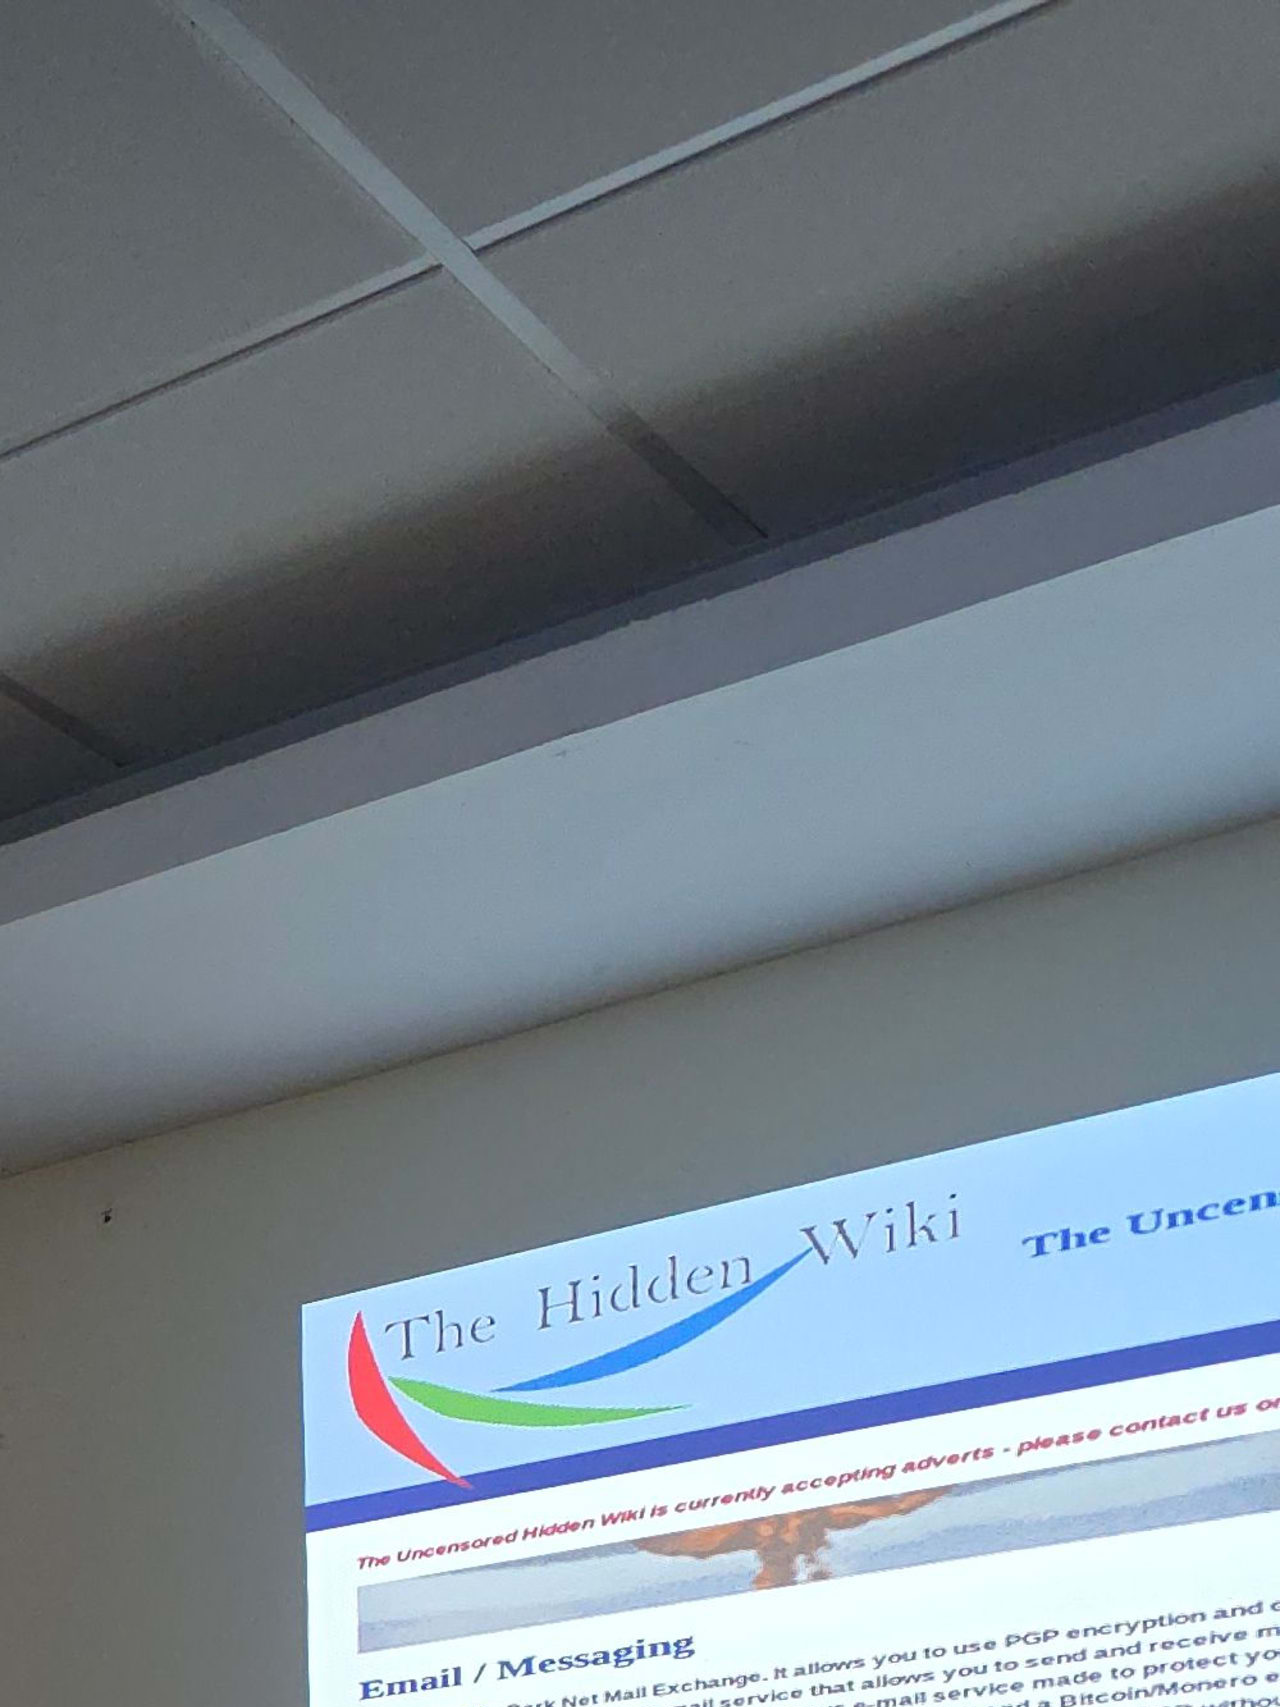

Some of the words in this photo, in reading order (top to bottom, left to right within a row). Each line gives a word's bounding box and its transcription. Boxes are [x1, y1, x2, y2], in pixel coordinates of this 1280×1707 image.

[1021, 1226, 1111, 1258] The
[1126, 1189, 1280, 1235] Uncen
[385, 1309, 496, 1360] The
[538, 1254, 753, 1330] Hidden
[800, 1193, 962, 1266] Wiki
[357, 1553, 391, 1570] The
[397, 1530, 518, 1562] Uncensored
[522, 1517, 595, 1541] Hidden
[601, 1504, 645, 1526] Wiki
[650, 1503, 668, 1518] is
[675, 1484, 777, 1513] currently
[780, 1462, 897, 1495] accepting
[901, 1443, 994, 1474] adverts
[1016, 1428, 1102, 1456] please
[1108, 1407, 1210, 1438] contact
[1216, 1402, 1248, 1420] us
[358, 1665, 462, 1701] Email
[497, 1635, 696, 1681] Messaging
[604, 1686, 647, 1703] Mail
[653, 1672, 769, 1697] Exchange.
[773, 1667, 788, 1680] It
[793, 1656, 866, 1678] allows
[872, 1650, 918, 1671] you
[923, 1644, 947, 1660] to
[953, 1639, 997, 1655] use
[1004, 1629, 1060, 1648] PGP
[1066, 1611, 1207, 1640] encryption
[1213, 1600, 1263, 1620] and
[810, 1680, 855, 1696] that
[861, 1670, 935, 1691] allows
[942, 1663, 988, 1682] you
[994, 1660, 1019, 1673] to
[1025, 1648, 1087, 1669] send
[1093, 1640, 1141, 1660] and
[1149, 1629, 1248, 1653] receive
[933, 1680, 1025, 1702] service
[1032, 1669, 1102, 1690] made
[1110, 1665, 1136, 1679] to
[1143, 1651, 1238, 1681] protect
[1245, 1648, 1280, 1667] yo
